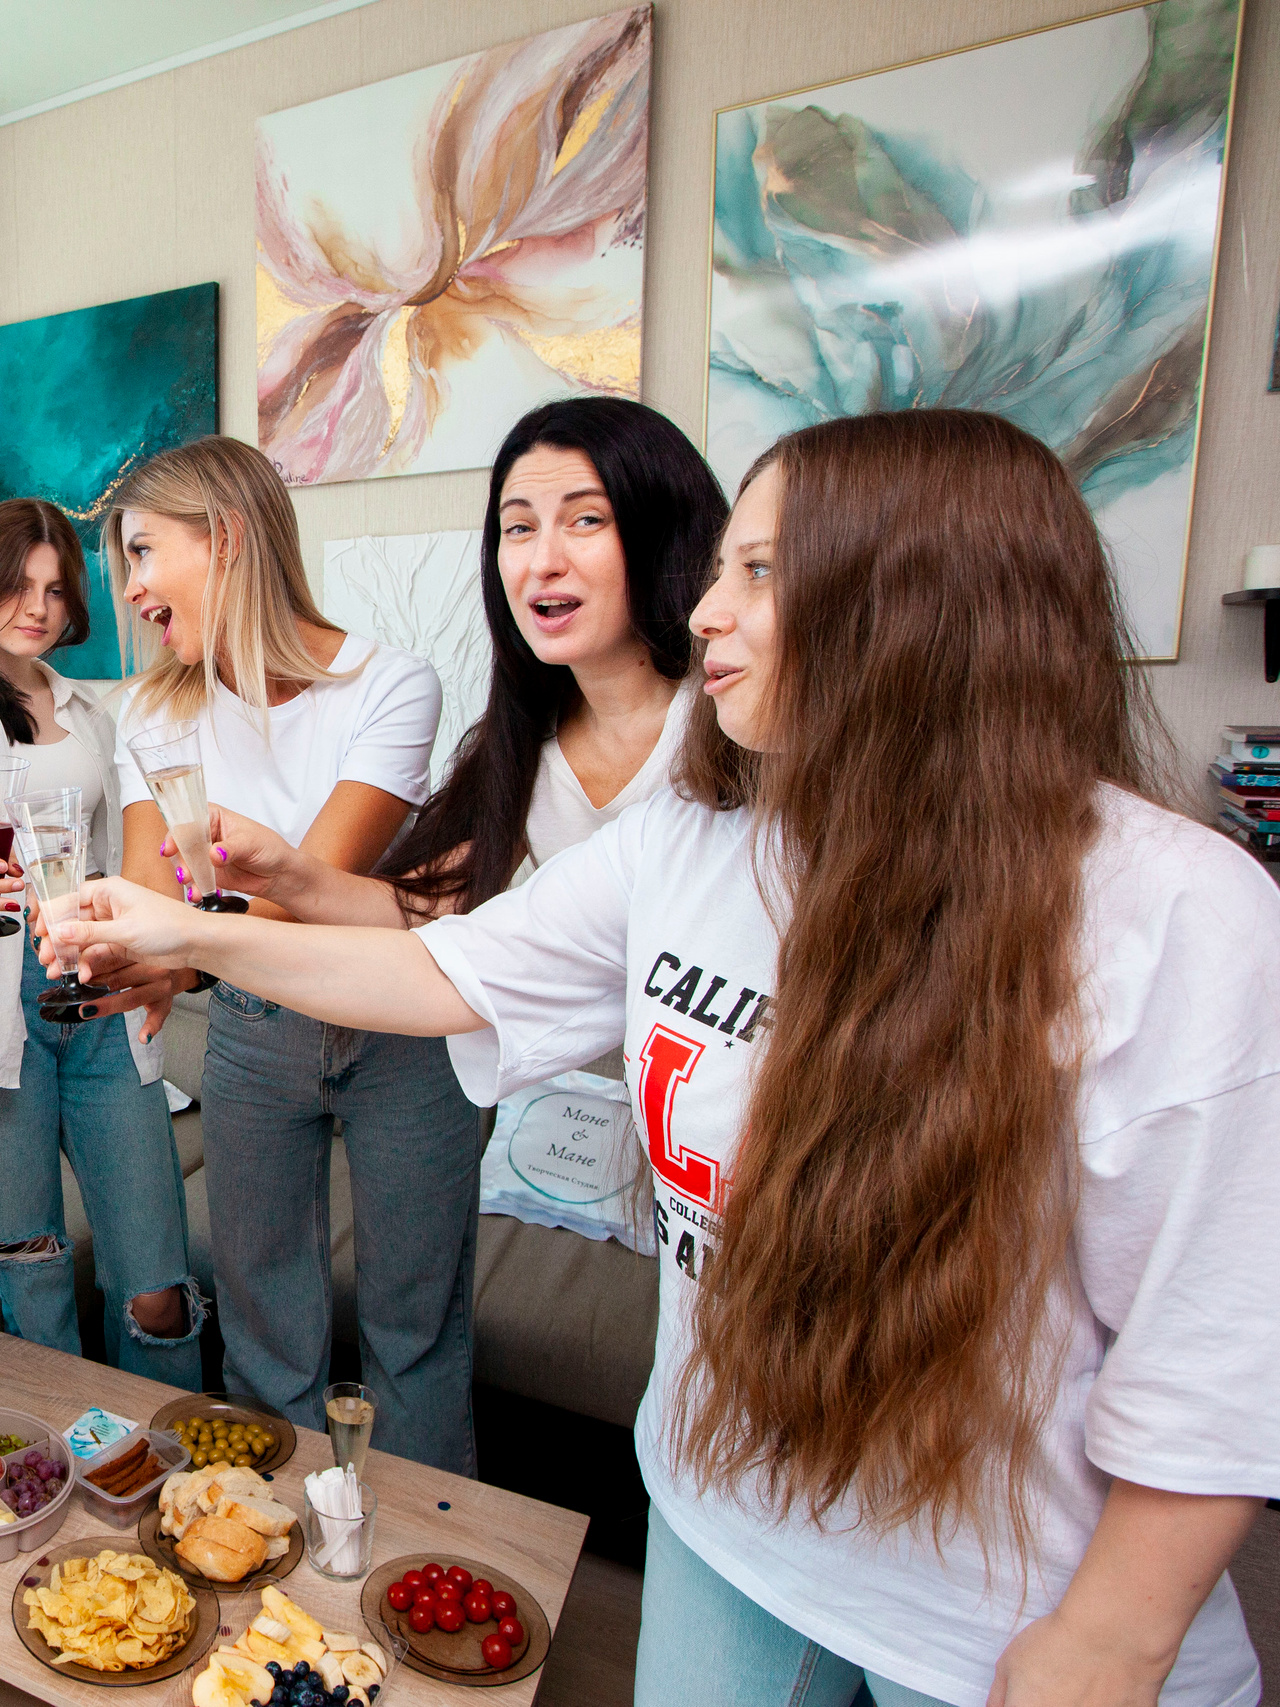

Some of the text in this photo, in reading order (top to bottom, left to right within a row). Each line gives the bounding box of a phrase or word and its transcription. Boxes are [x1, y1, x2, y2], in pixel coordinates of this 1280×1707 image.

[272, 458, 310, 484] Puline
[562, 1106, 610, 1127] Моне
[571, 1129, 590, 1142] &
[546, 1143, 597, 1167] Мане
[527, 1164, 599, 1190] Творческая Студия
